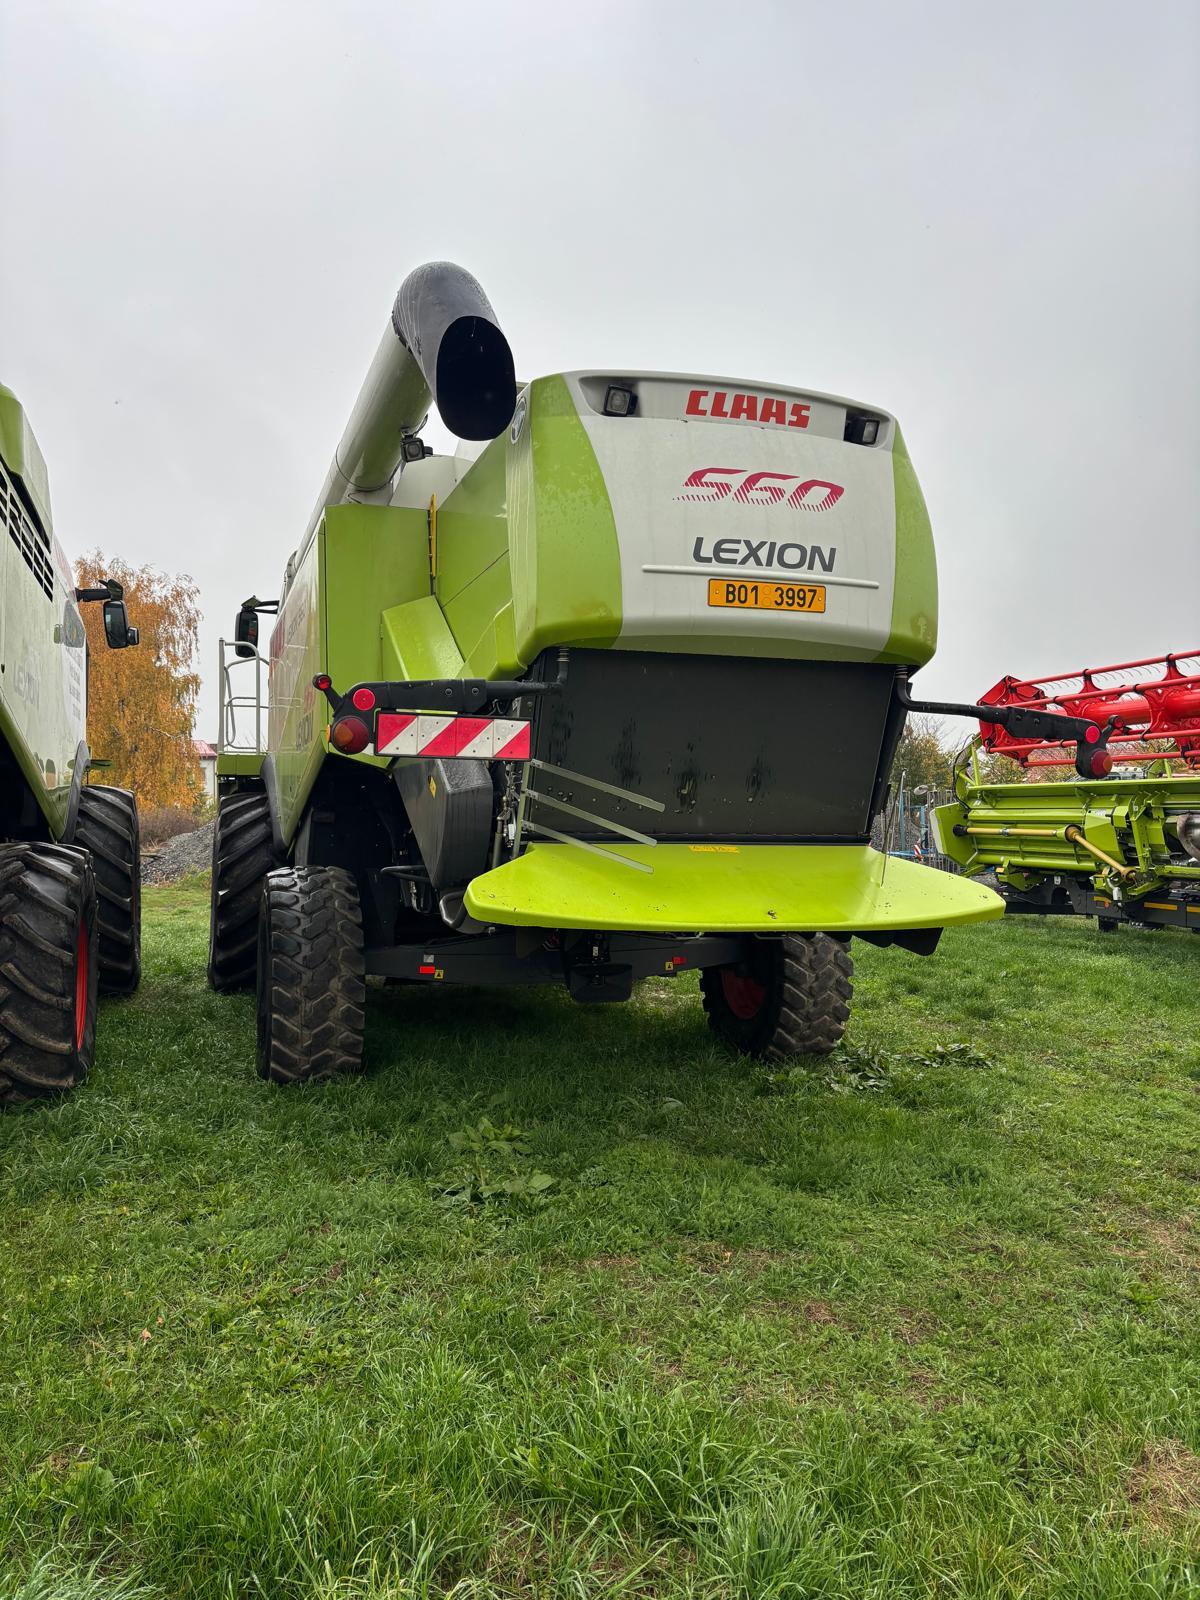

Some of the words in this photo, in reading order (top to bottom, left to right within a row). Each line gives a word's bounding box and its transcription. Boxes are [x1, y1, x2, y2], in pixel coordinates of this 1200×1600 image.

[685, 389, 811, 429] CLAAS
[672, 467, 845, 512] 560
[692, 536, 837, 572] LEXION
[725, 583, 759, 605] B01
[774, 586, 818, 609] 3997
